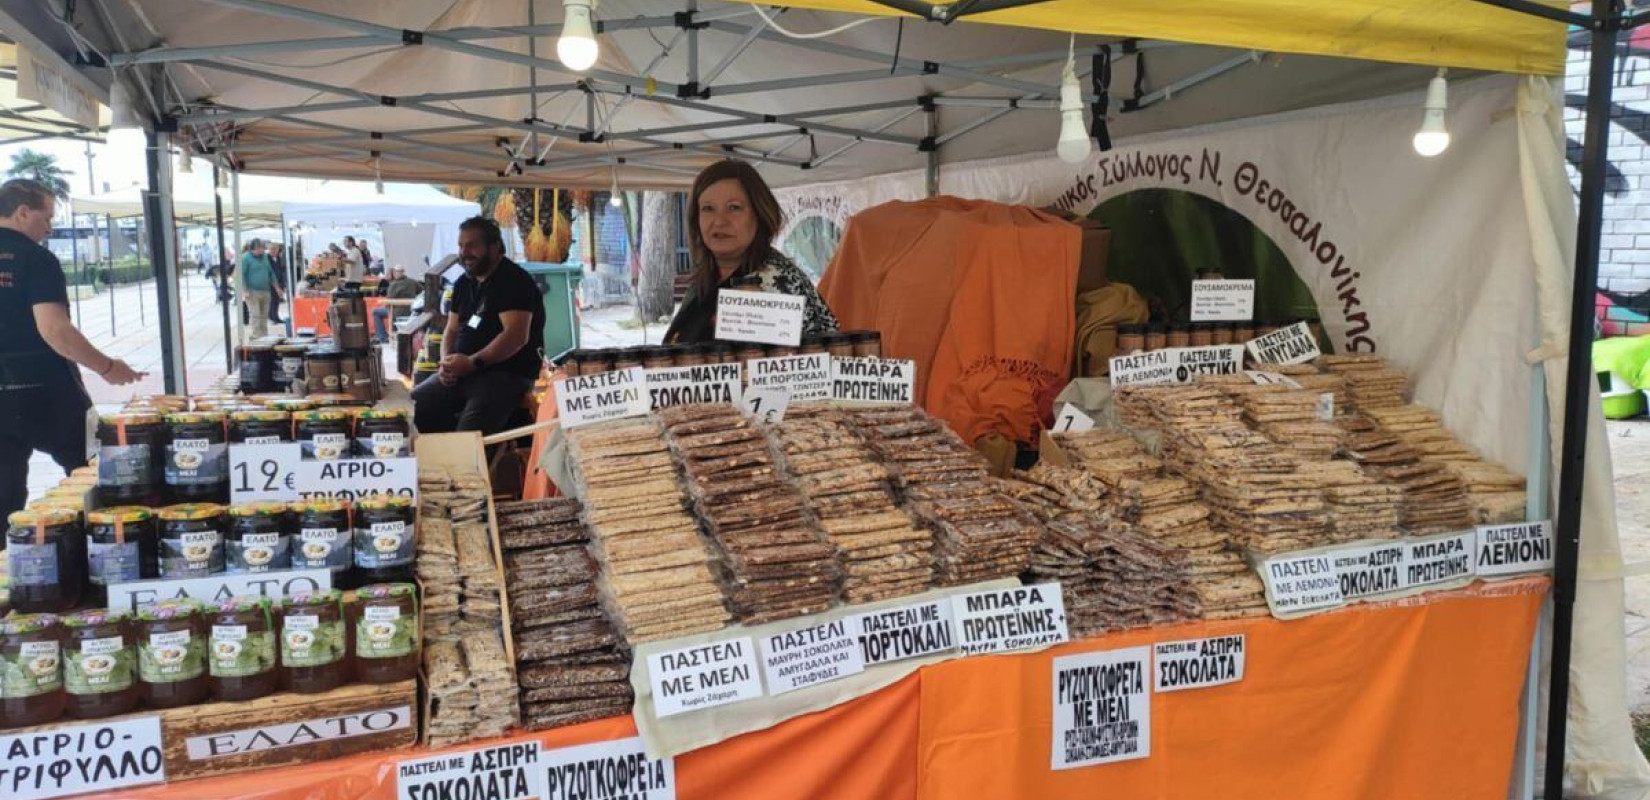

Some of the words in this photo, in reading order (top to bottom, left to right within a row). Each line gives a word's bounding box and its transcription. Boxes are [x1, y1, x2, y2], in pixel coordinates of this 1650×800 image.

[1099, 151, 1192, 187] Σύλλογος
[1234, 161, 1375, 353] Θεσσαλονίκης
[719, 296, 801, 311] ΣΟΥΣΑΜΟΚΡΕΜΑ
[757, 356, 820, 374] ΠΑΣΤΕΛΙ
[1114, 352, 1167, 371] ΠΑΣΤΕΛΙ
[1180, 350, 1217, 363] ΠΑΣΤΕΛΙ
[1219, 348, 1232, 360] ΜΕ
[565, 370, 633, 393] ΠΑΣΤΕΛΙ
[646, 372, 678, 382] ΠΑΣΤΕΛΙ
[691, 366, 738, 382] ΜΑΥΡΗ
[752, 377, 767, 386] ΜΕ
[770, 371, 827, 384] ΠΟΡΤΟΚΑΛΙ
[840, 362, 902, 378] ΜΠΑΡΑ
[566, 396, 591, 412] ΜΕ
[596, 388, 639, 406] ΜΕΛΙ
[650, 382, 732, 411] ΣΟΚΟΛΑΤΑ
[176, 440, 207, 448] ΕΛΑΤΟ
[320, 461, 394, 480] ΑΓΡΙΟ-
[185, 533, 216, 543] ΕΛΑΤΟ
[245, 535, 278, 544] ΕΛΑΤΟ
[304, 531, 335, 540] ΕΛΑΤΟ
[375, 524, 404, 533] ΕΛΑΤΟ
[1487, 527, 1527, 543] ΠΑΣΤΕΛΙ
[1529, 524, 1543, 538] ΜΕ
[1334, 557, 1357, 567] ΑΣΤΕΛΙ
[1368, 546, 1403, 567] ΑΣΠΡΗ
[1412, 538, 1463, 559] ΜΠΑΡΑ
[1479, 538, 1551, 567] ΛΕΜΟΝΙ
[1271, 558, 1330, 579] ΠΑΣΤΕΛΙ
[1276, 583, 1293, 594] ΜΕ
[1341, 565, 1398, 596] ΟΚΟΛΑΤΑ
[966, 588, 1044, 612] ΜΠΑΡΑ
[862, 608, 918, 633] ΠΑΣΤΕΛΙ
[920, 604, 939, 622] ΜΕ
[963, 608, 1056, 642] ΠΡΩΤΕΪΝΗΣ
[770, 621, 844, 653] ΠΑΣΤΕΛΙ
[1004, 634, 1062, 649] ΣΟΚΟΛΑΤΑ
[1157, 643, 1184, 653] ΠΑΣΤΕΛΙ
[1187, 642, 1197, 651] ΜΕ
[1200, 637, 1242, 656] ΑΣΠΡΗ
[660, 642, 742, 672] ΠΑΣΤΕΛΙ
[768, 652, 801, 667] ΜΑΥΡΗ
[803, 638, 854, 657] ΣΟΚΟΛΑΤΑ
[778, 656, 831, 677] ΑΜΥΓΔΑΛΑ
[833, 652, 849, 663] ΚΑΙ
[1161, 654, 1235, 687] ΣΟΚΟΛΑΤΑ
[661, 675, 694, 697] ΜΕ
[699, 664, 750, 689] ΜΕΛΙ
[1059, 661, 1143, 704] ΡΥΖΟΓΚΟΦΡΕΤΑ
[1073, 701, 1093, 727] ΜΕ
[1097, 696, 1130, 725] ΜΕΛΙ
[8, 727, 132, 760] ΑΓΡΙΟ-
[208, 711, 399, 755] ΕΛΑΤΟ
[401, 760, 446, 777] ΠΑΣΤΕΛΙ
[449, 757, 465, 769] ΜΕ
[471, 743, 537, 773] ΑΣΠΡΗ
[408, 767, 529, 800] ΣΟΚΟΛΑΤΑ
